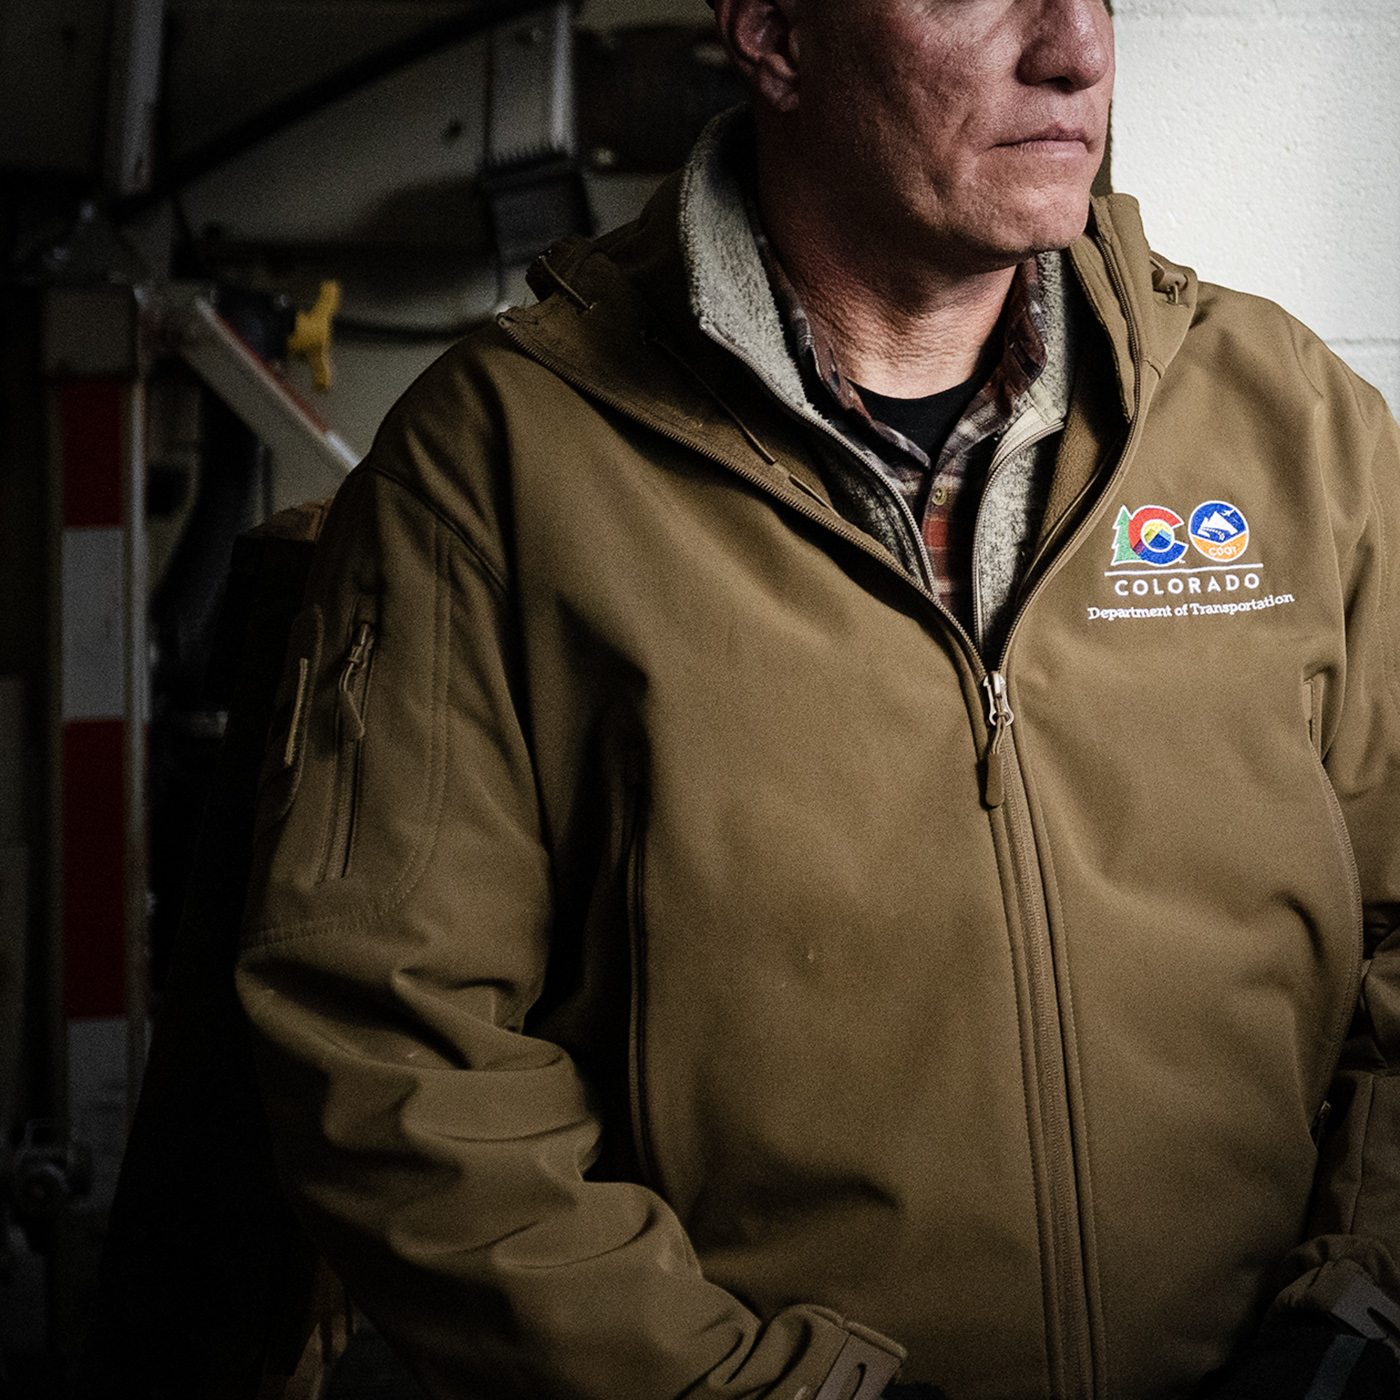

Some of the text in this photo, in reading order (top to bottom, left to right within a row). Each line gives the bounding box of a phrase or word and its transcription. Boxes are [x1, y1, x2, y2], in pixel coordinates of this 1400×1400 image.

[1113, 572, 1261, 597] COLORADO
[1086, 593, 1296, 621] Department of Transportation
